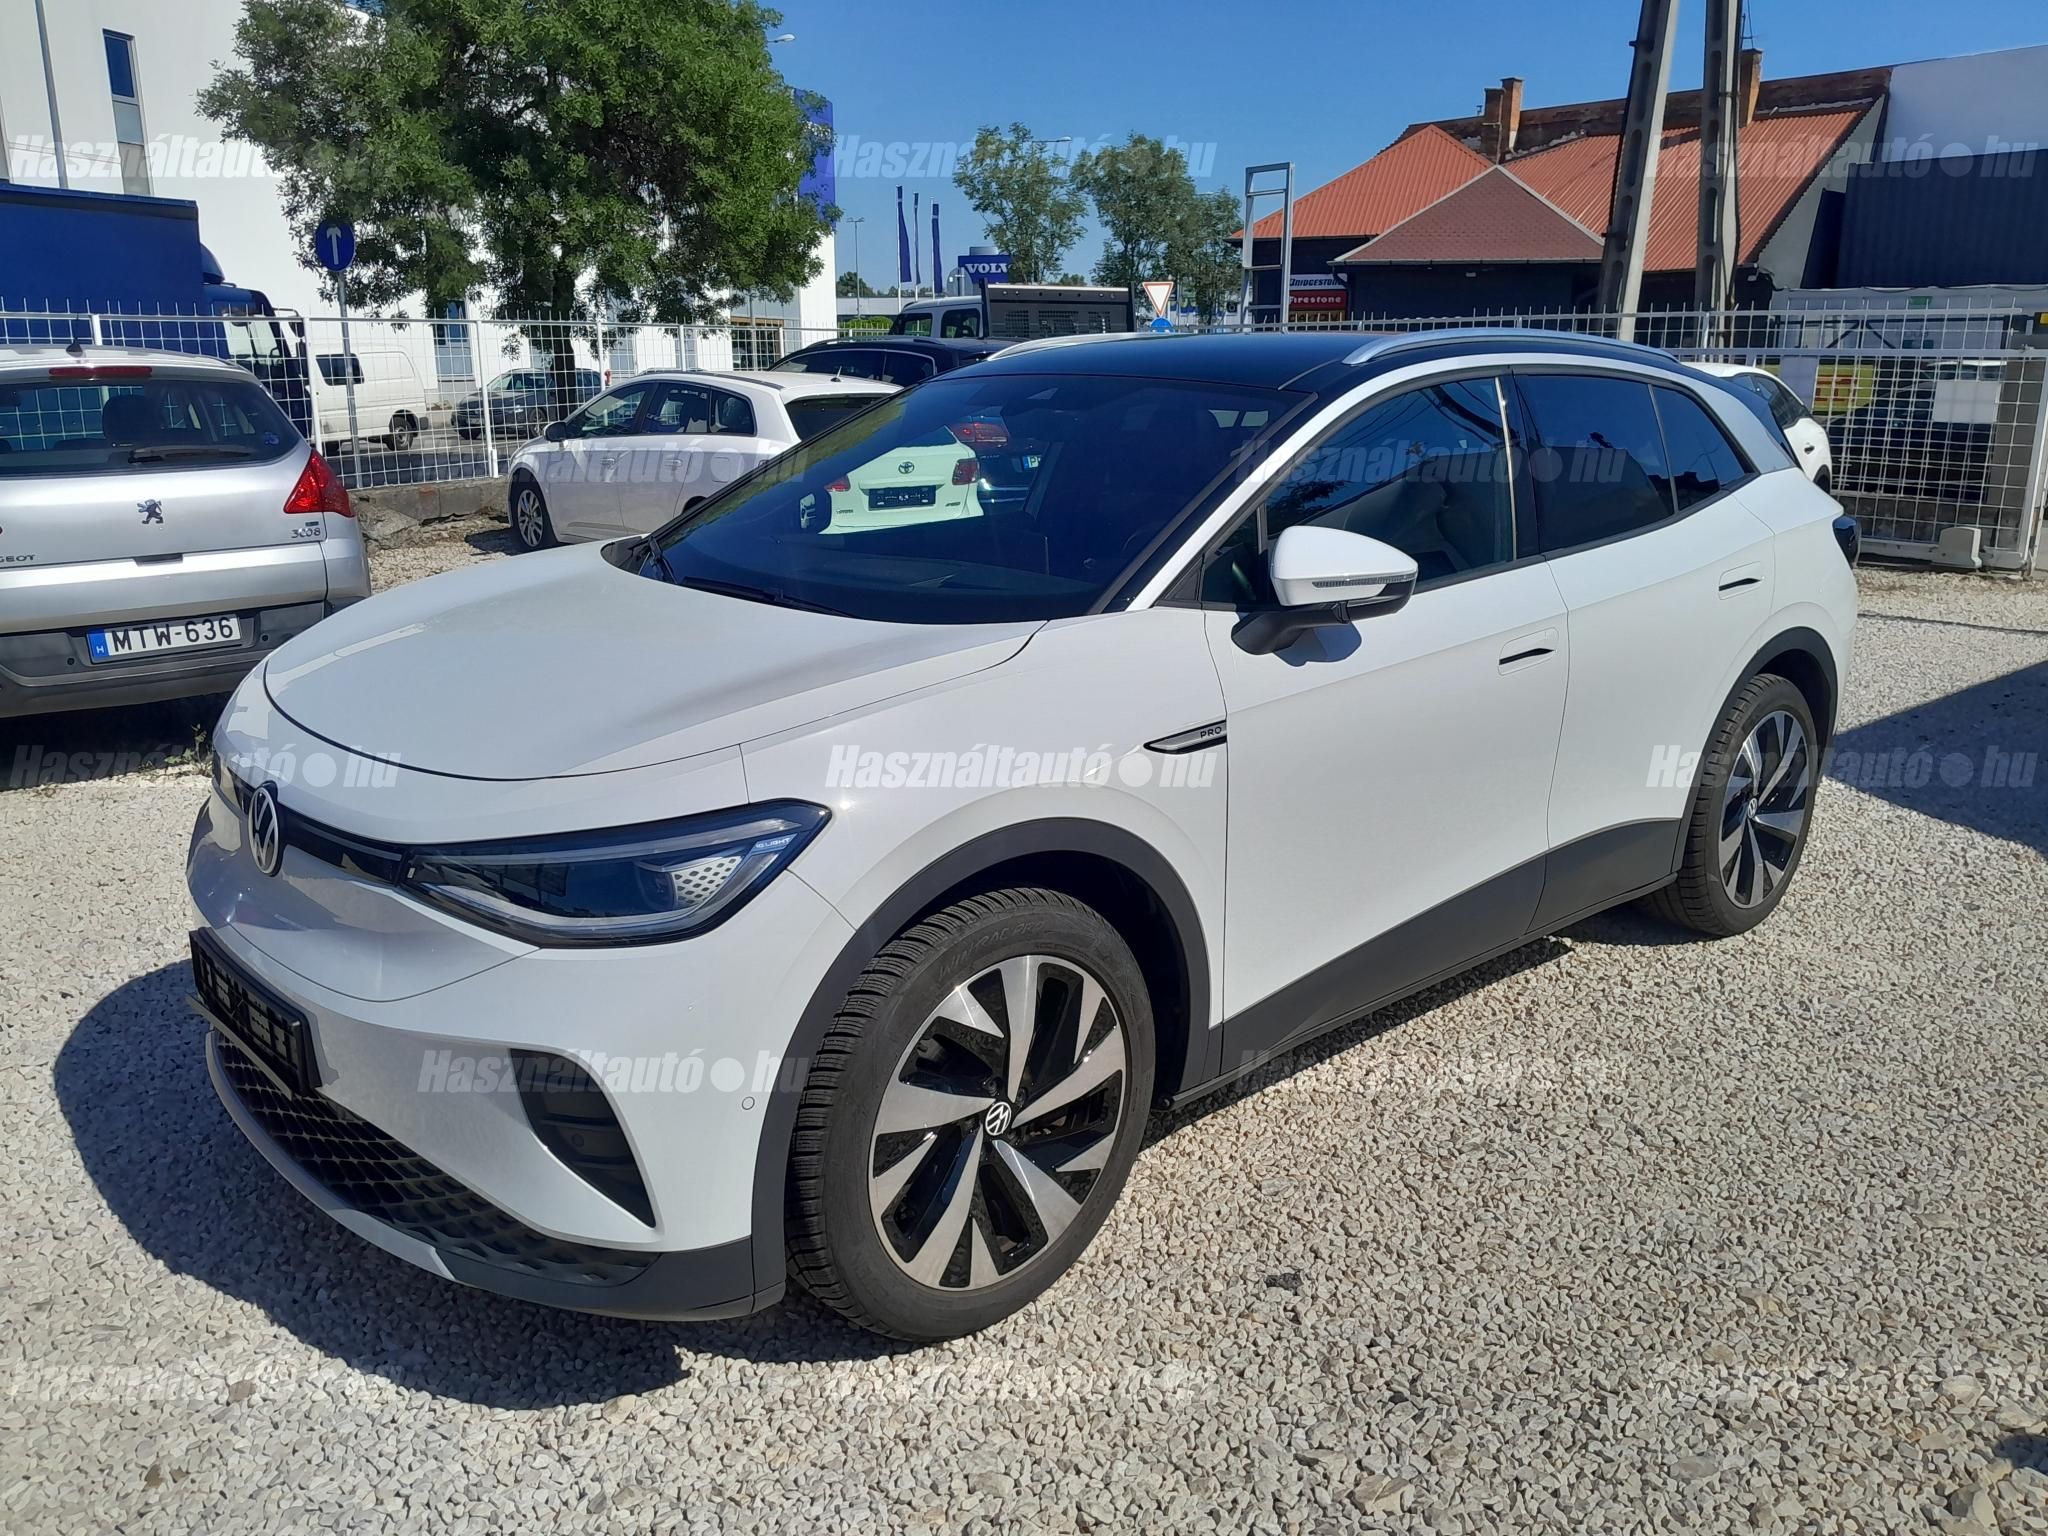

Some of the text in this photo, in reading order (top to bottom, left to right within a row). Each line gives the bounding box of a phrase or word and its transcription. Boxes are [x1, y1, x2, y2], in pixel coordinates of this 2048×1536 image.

[965, 263, 1008, 273] VOLV
[291, 528, 321, 538] 3008
[96, 617, 234, 654] H MTW-636
[1200, 726, 1222, 739] PRO
